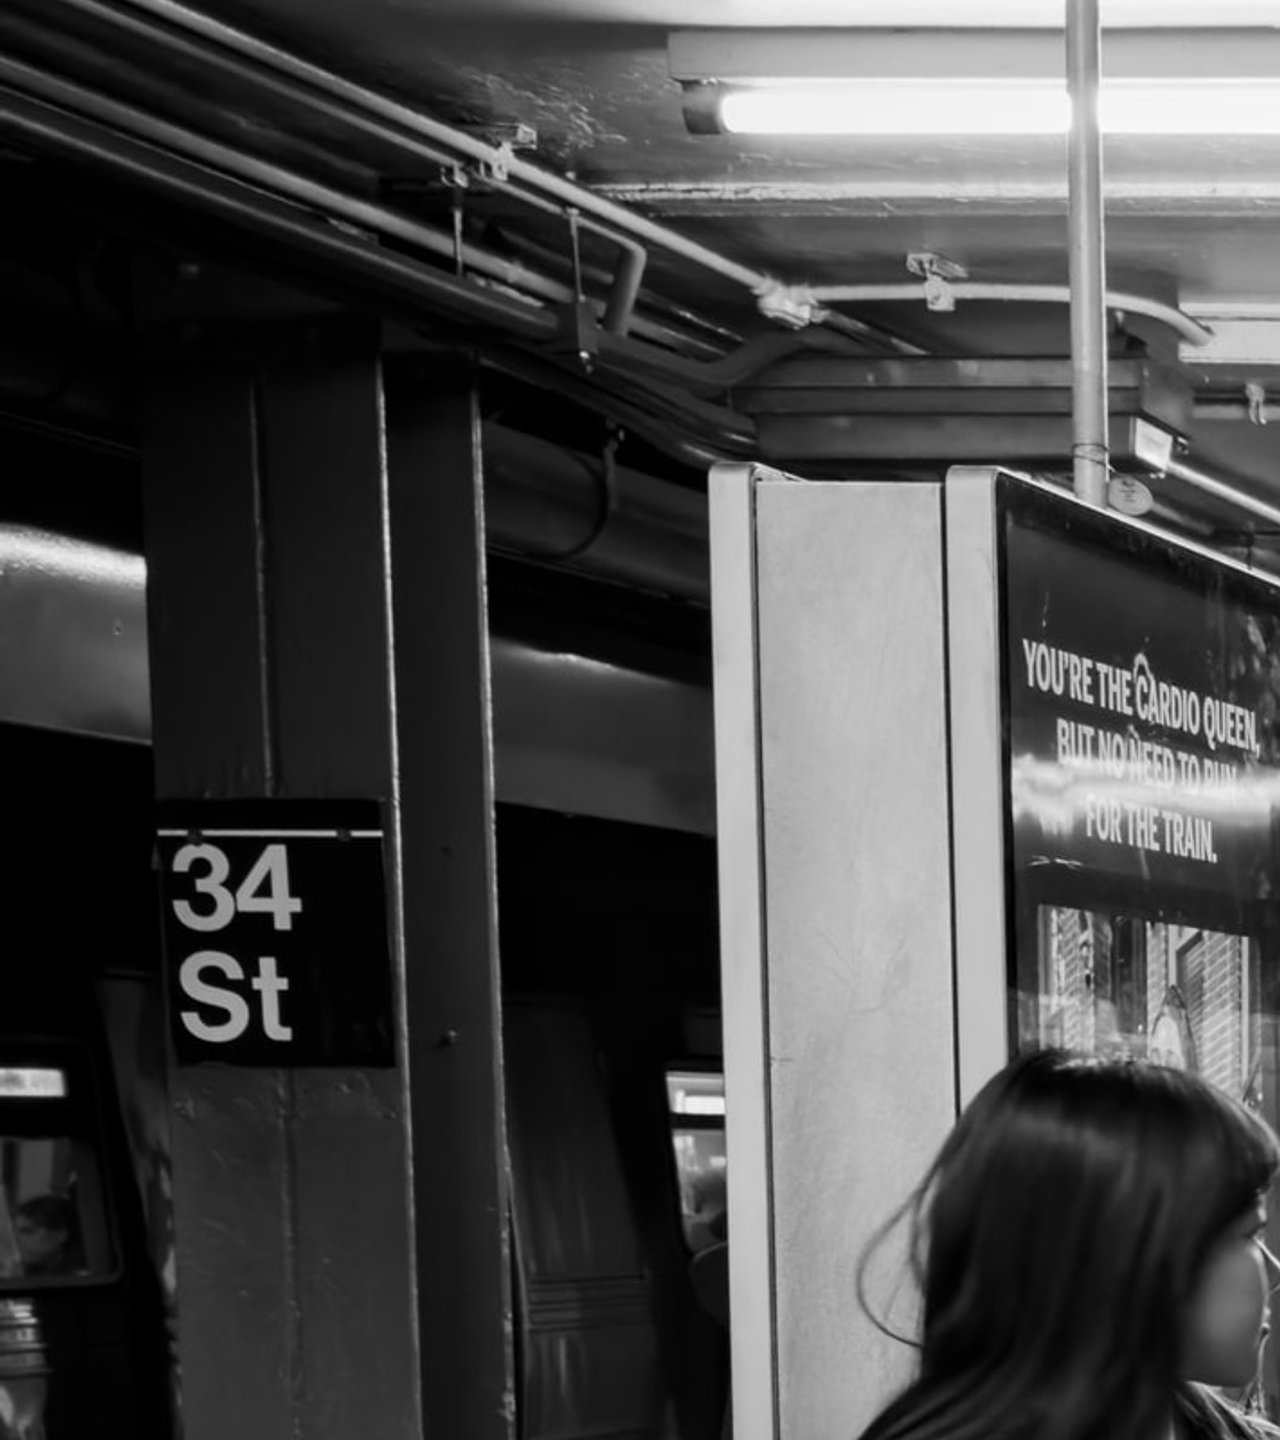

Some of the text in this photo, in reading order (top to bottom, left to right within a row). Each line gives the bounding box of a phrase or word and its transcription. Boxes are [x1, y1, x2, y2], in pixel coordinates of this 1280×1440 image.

[1022, 638, 1260, 759] YOU'RE THE CARDIO QUEEN,
[1057, 717, 1095, 766] BUT
[1098, 728, 1125, 778] NO
[1129, 738, 1175, 789] NEED
[1176, 751, 1200, 794] TO
[1085, 792, 1218, 864] FOR THE TRAIN.
[172, 843, 303, 932] 34
[179, 950, 293, 1043] St
